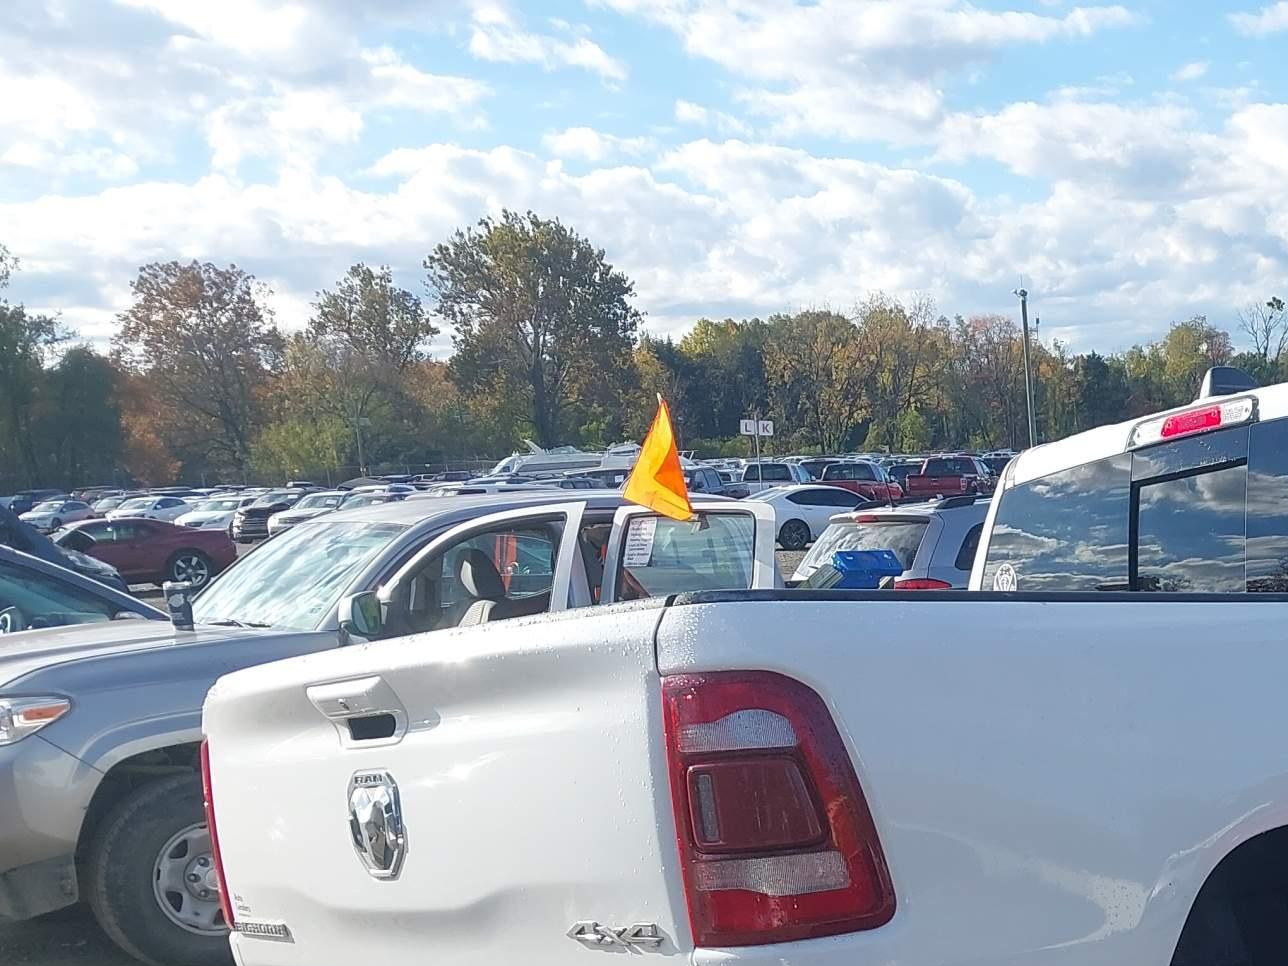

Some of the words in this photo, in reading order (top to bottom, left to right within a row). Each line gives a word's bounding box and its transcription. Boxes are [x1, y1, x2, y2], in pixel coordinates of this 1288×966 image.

[745, 422, 751, 432] L
[762, 423, 770, 433] K
[354, 774, 383, 785] RAM
